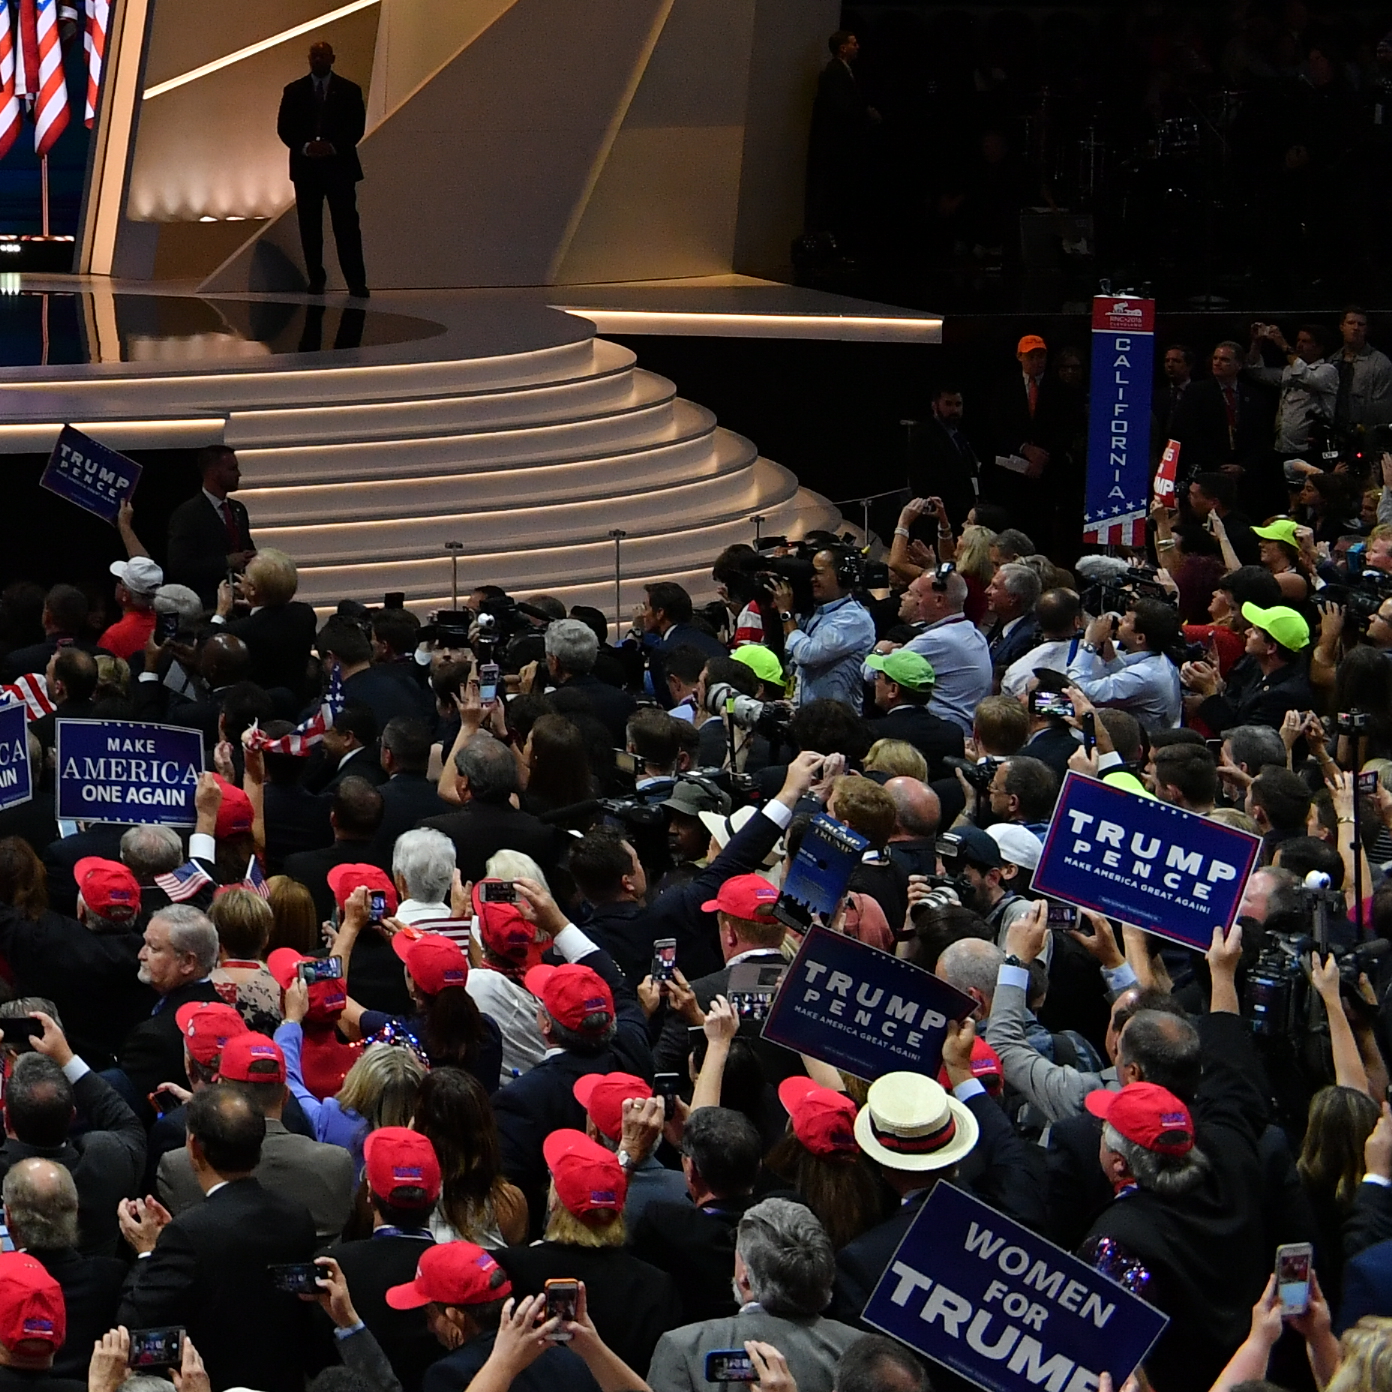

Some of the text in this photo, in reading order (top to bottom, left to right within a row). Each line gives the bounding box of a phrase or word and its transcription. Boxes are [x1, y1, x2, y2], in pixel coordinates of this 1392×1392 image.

[1107, 337, 1131, 500] CALIFORNIA
[59, 459, 119, 498] PENCE
[60, 442, 131, 490] TRUMP
[61, 756, 199, 786] AMERICA
[107, 737, 156, 754] MAKE
[81, 784, 186, 808] ONE AGAIN
[1068, 808, 1236, 884] TRUMP
[1063, 856, 1092, 874] MAKE
[1092, 867, 1139, 889] AMERICA
[1140, 883, 1173, 902] GREAT
[1174, 896, 1212, 915] AGAIN!
[1072, 848, 1213, 902] PENCE
[802, 988, 924, 1050] PENCE
[804, 959, 947, 1033] TRUMP
[794, 1005, 818, 1021] MAKE
[819, 1014, 857, 1038] AMERICA
[859, 1032, 887, 1050] GREAT
[889, 1045, 922, 1062] AGAIN!
[964, 1220, 1116, 1329] WOMEN
[982, 1279, 1049, 1332] FOR
